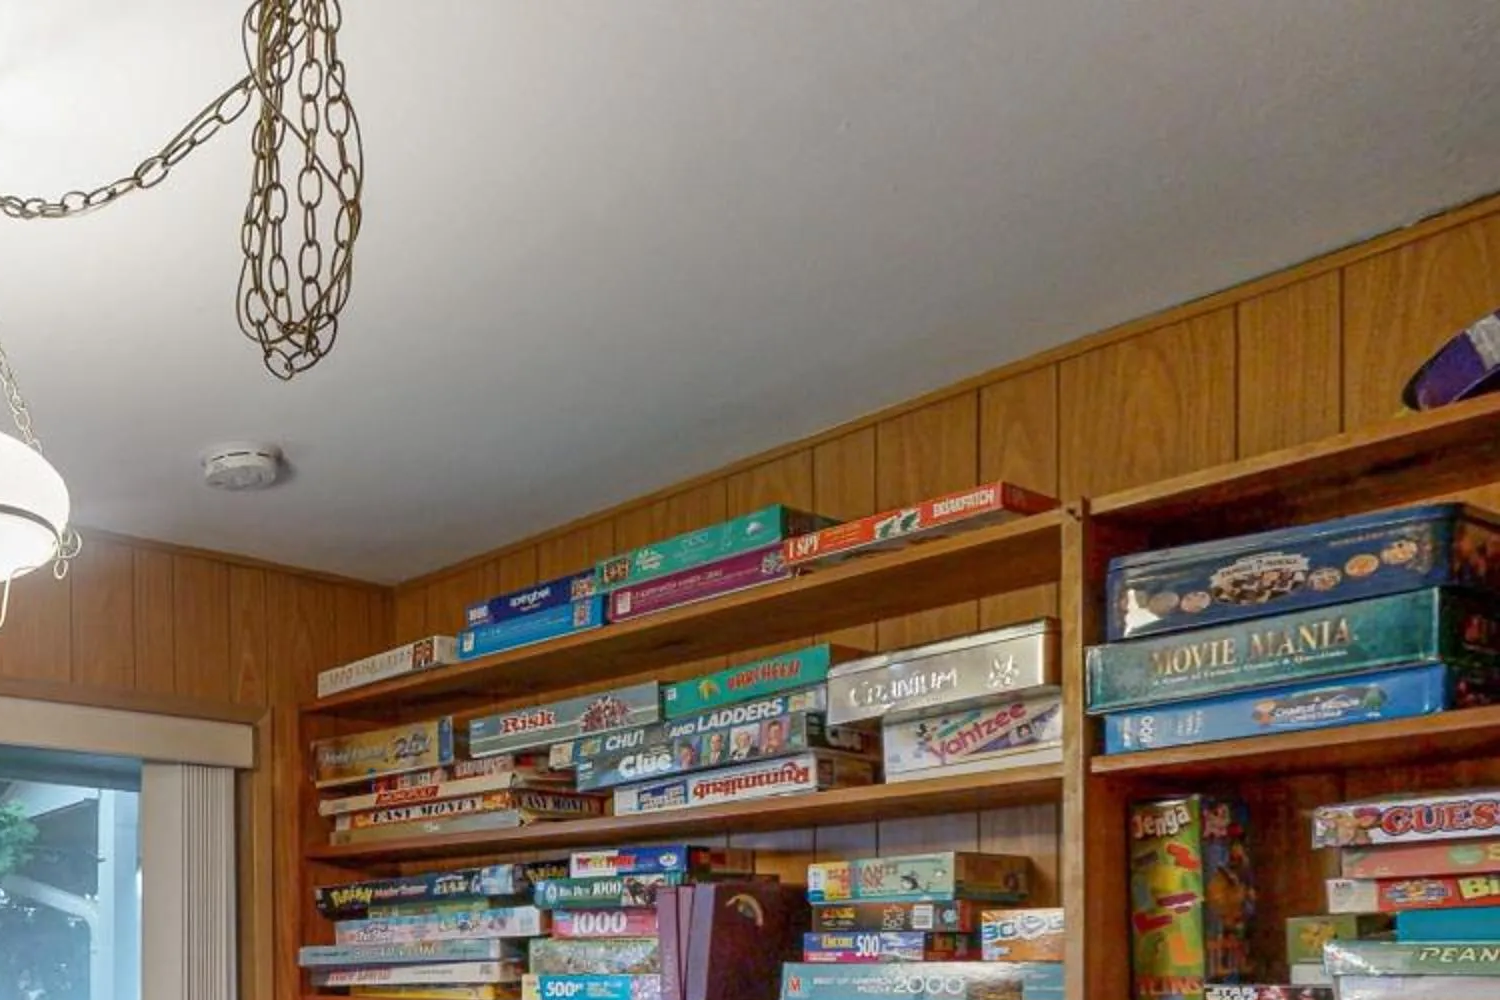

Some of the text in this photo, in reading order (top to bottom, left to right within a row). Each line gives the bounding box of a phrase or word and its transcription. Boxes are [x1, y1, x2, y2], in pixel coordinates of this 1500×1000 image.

[797, 532, 821, 556] SPY
[1151, 638, 1238, 677] MOVIE
[1250, 617, 1353, 658] MANIA
[697, 698, 783, 732] LADDERS
[618, 752, 674, 779] Clue
[571, 911, 628, 934] 1000
[856, 934, 880, 957] 500
